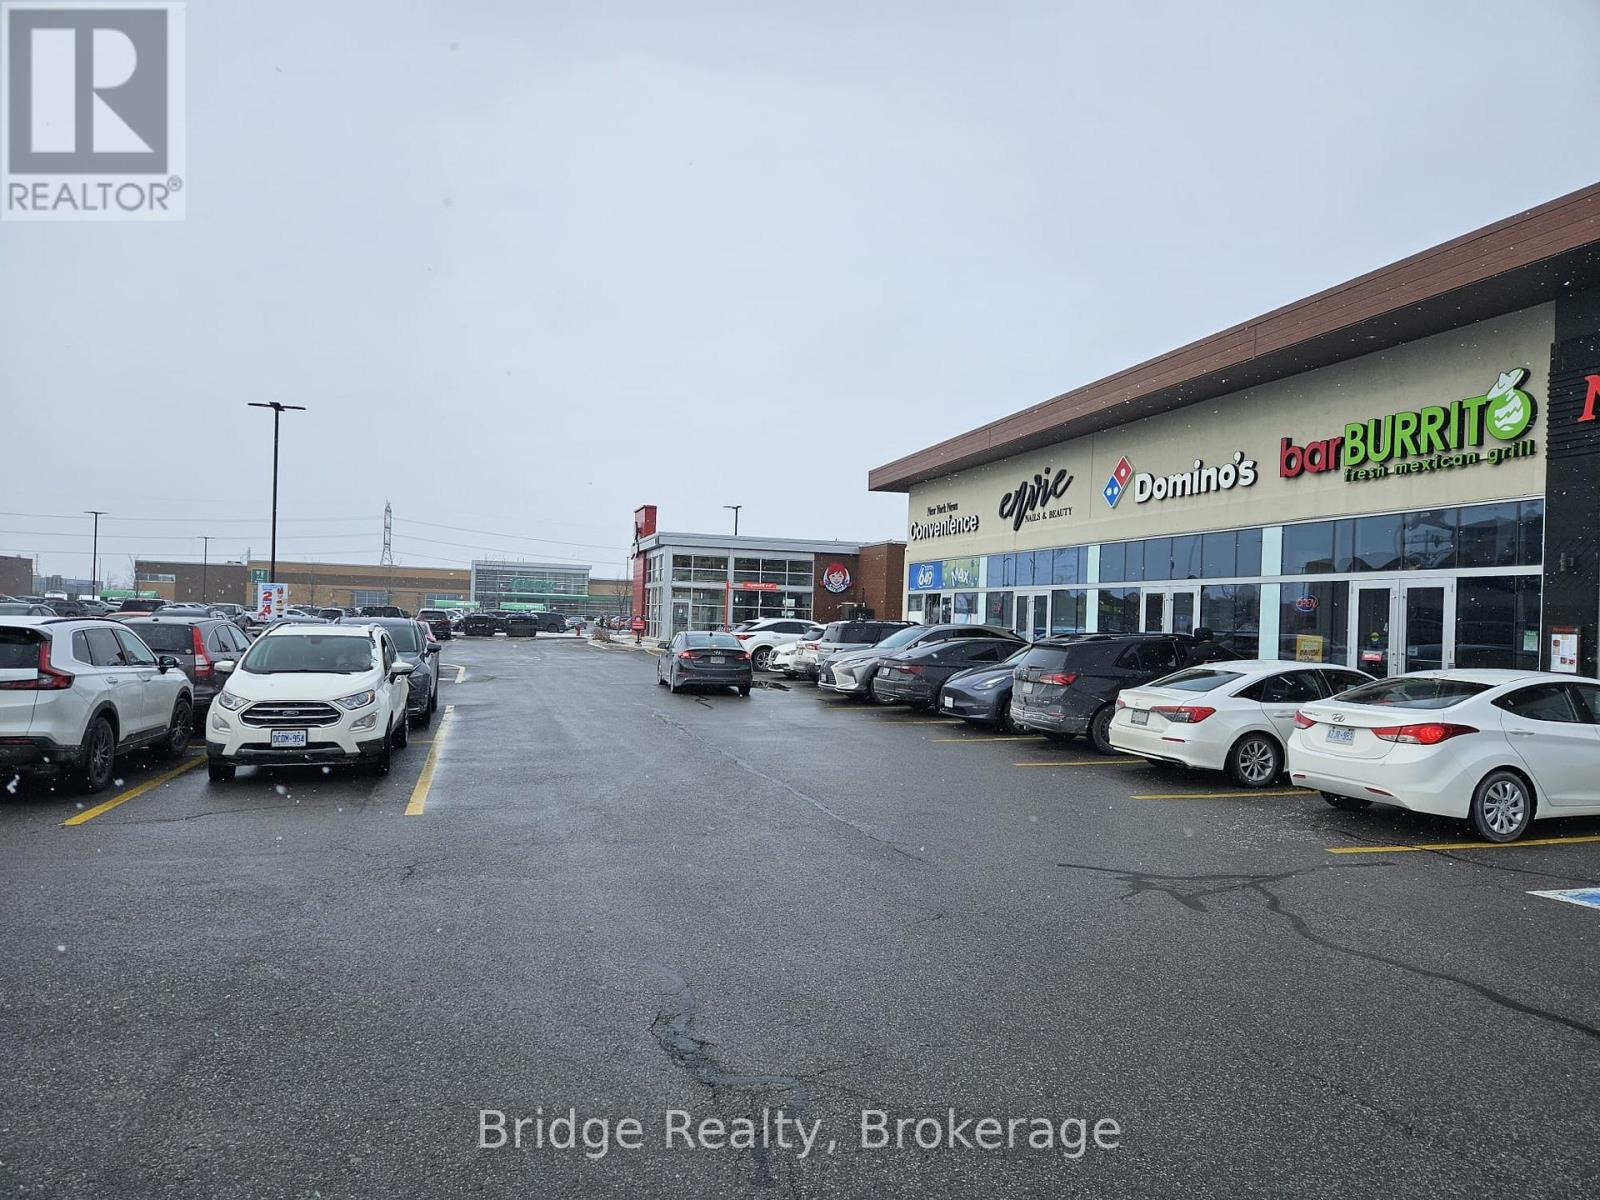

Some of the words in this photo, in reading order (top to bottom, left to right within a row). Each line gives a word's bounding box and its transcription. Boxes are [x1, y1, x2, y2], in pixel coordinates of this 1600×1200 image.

[1134, 451, 1257, 503] Domino's
[1344, 464, 1388, 482] fresh
[1394, 451, 1480, 475] mexican
[1487, 439, 1536, 464] grill
[910, 515, 979, 541] Convenience
[1025, 512, 1041, 523] NAILS
[1049, 506, 1073, 519] BEAUTY
